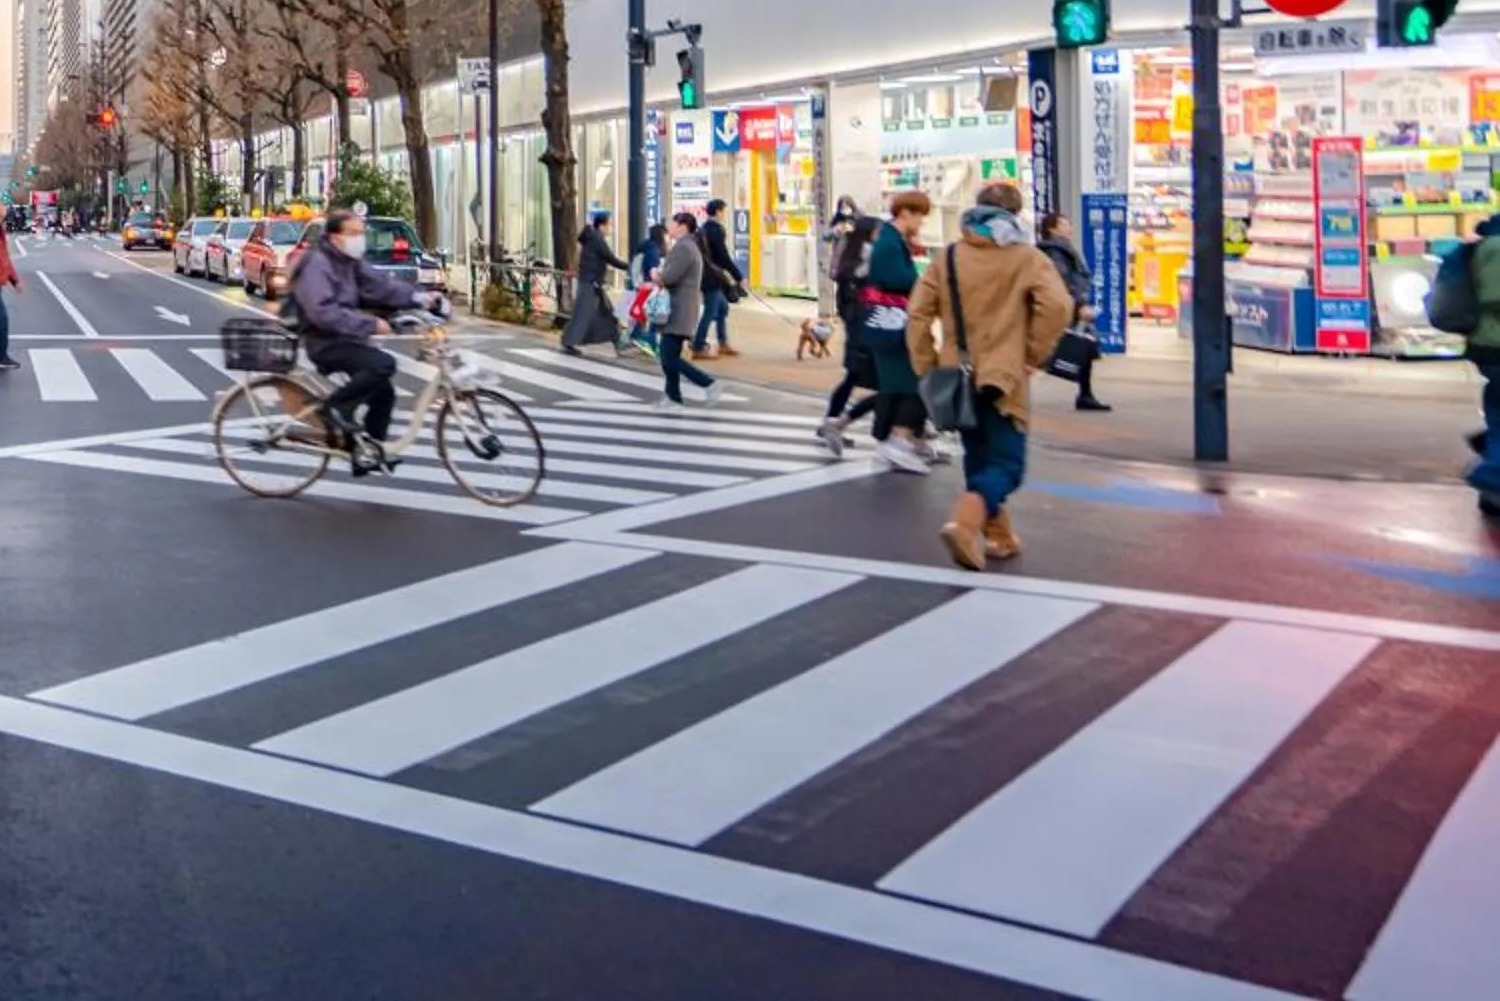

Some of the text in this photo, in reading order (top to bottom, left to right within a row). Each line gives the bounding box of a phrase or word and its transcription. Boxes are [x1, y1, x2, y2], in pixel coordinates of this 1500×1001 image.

[1258, 26, 1359, 51] 自転車を除く
